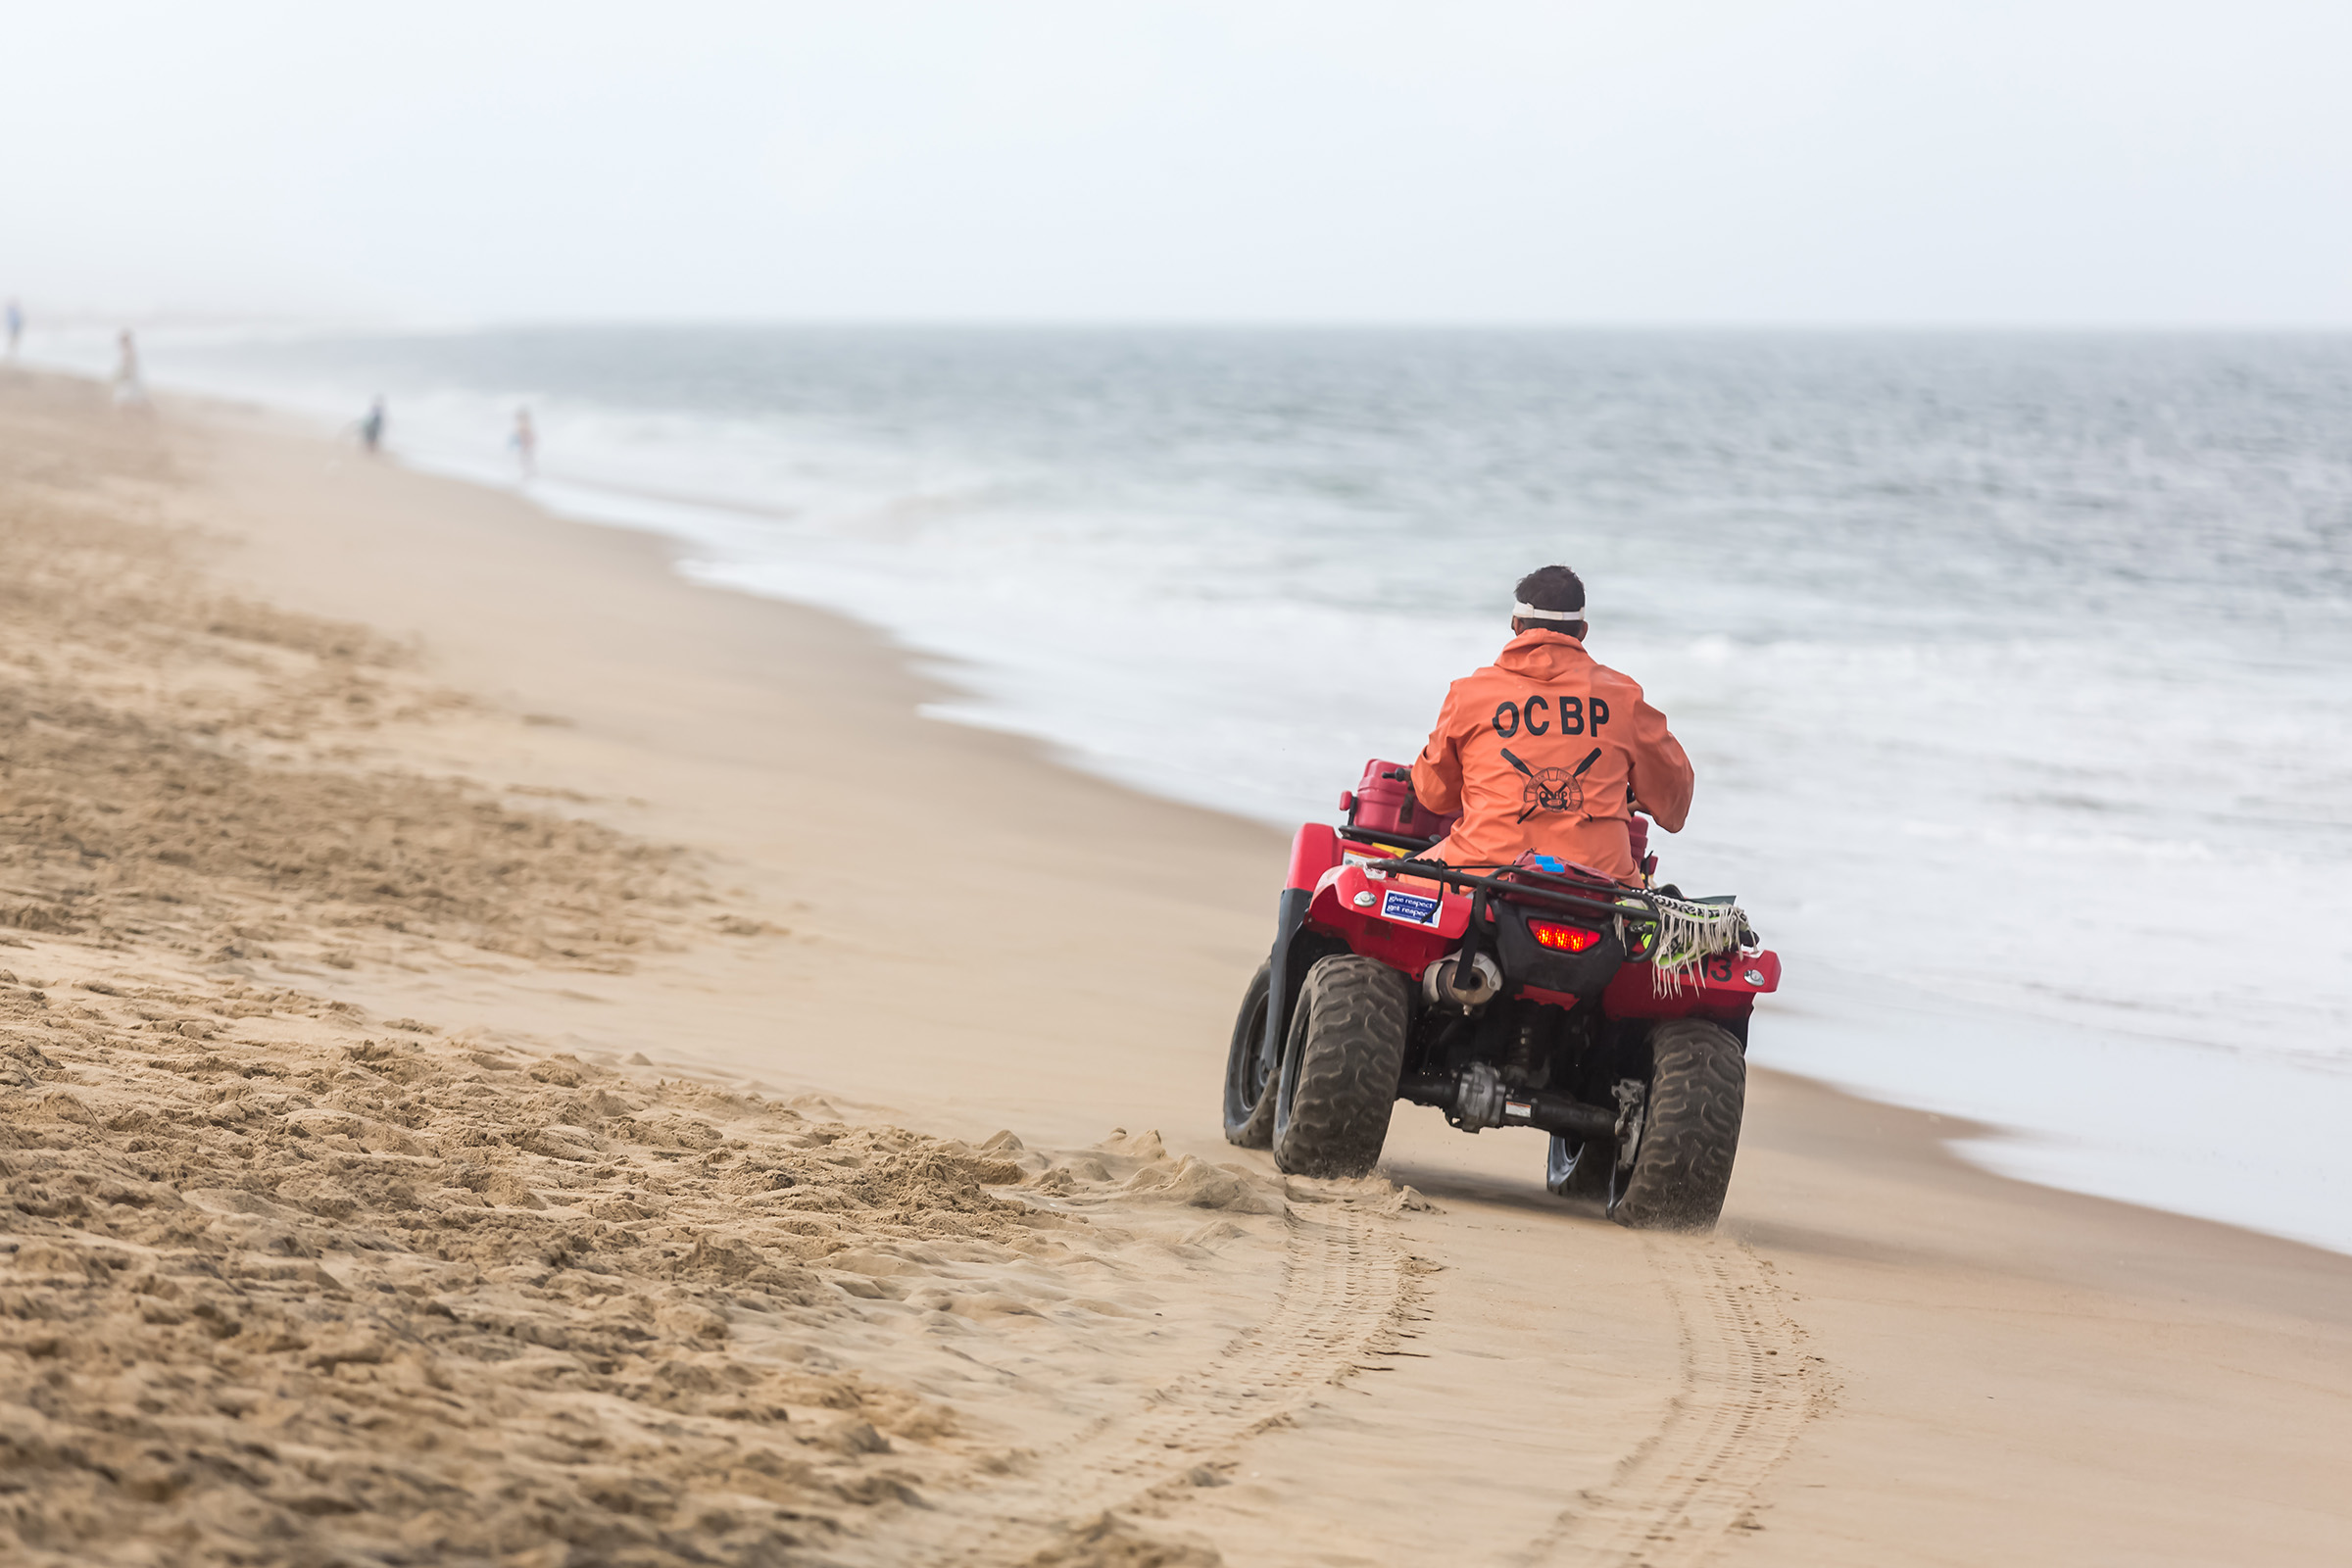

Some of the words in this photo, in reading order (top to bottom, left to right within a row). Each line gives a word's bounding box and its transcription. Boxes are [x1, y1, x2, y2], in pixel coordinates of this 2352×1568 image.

[1492, 695, 1609, 738] OCBP
[1404, 899, 1433, 908] respect
[1401, 907, 1429, 917] respec
